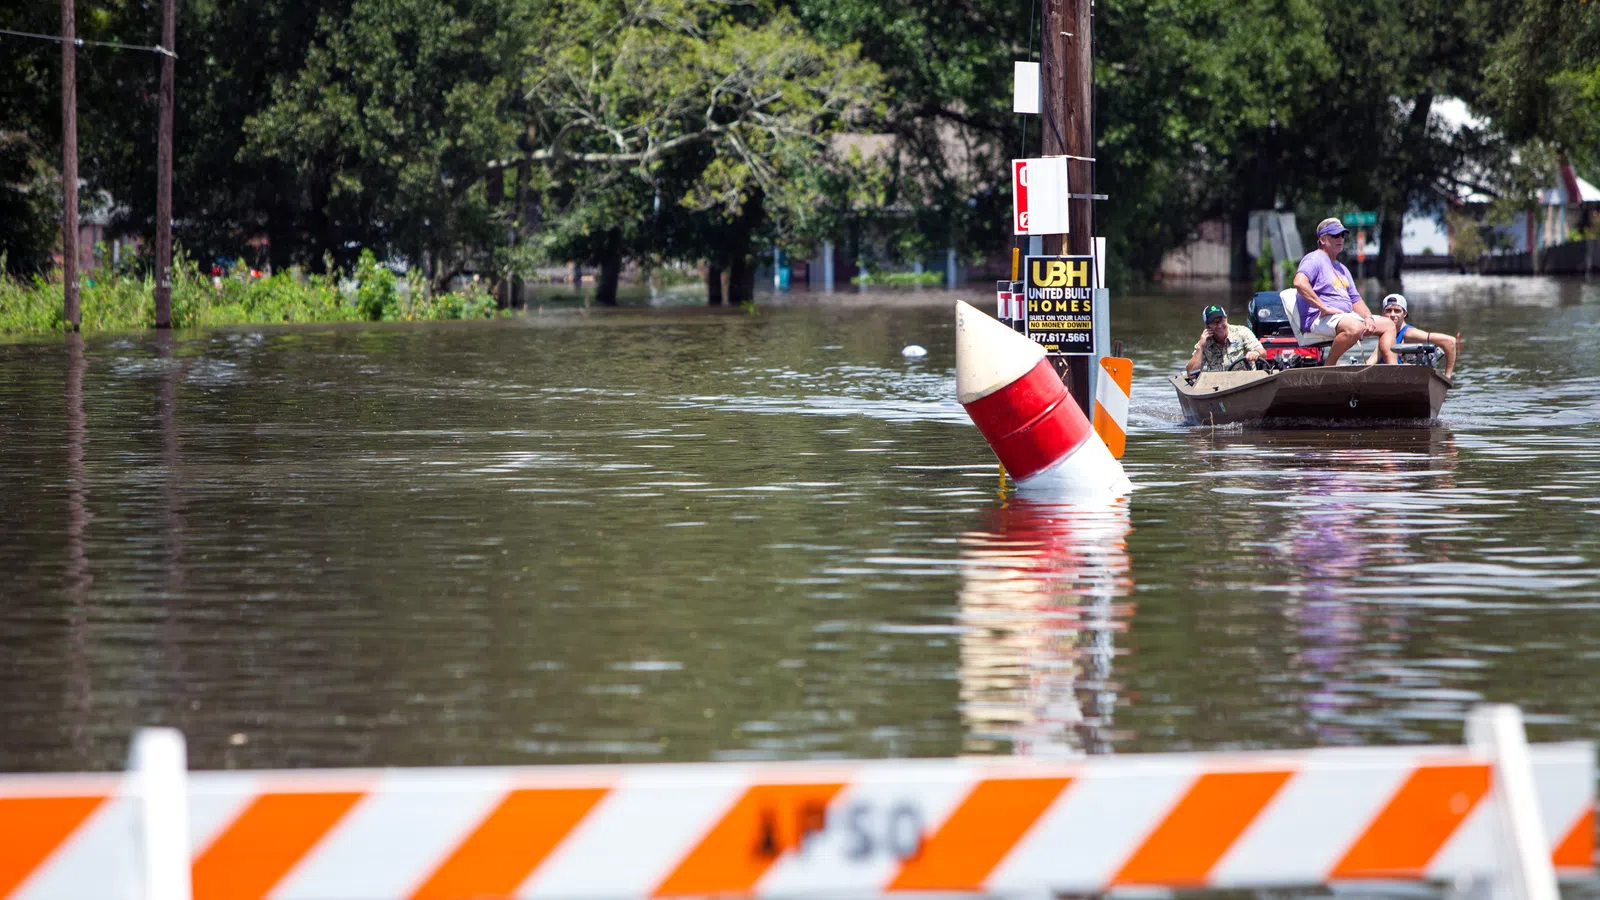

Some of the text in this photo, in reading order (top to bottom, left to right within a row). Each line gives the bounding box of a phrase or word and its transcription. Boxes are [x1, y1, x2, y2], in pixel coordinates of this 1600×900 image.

[1032, 261, 1088, 287] UBH
[1028, 287, 1091, 300] UNITED BUILT
[1028, 300, 1091, 312] HOMES
[1030, 332, 1090, 342] 877.617.5661
